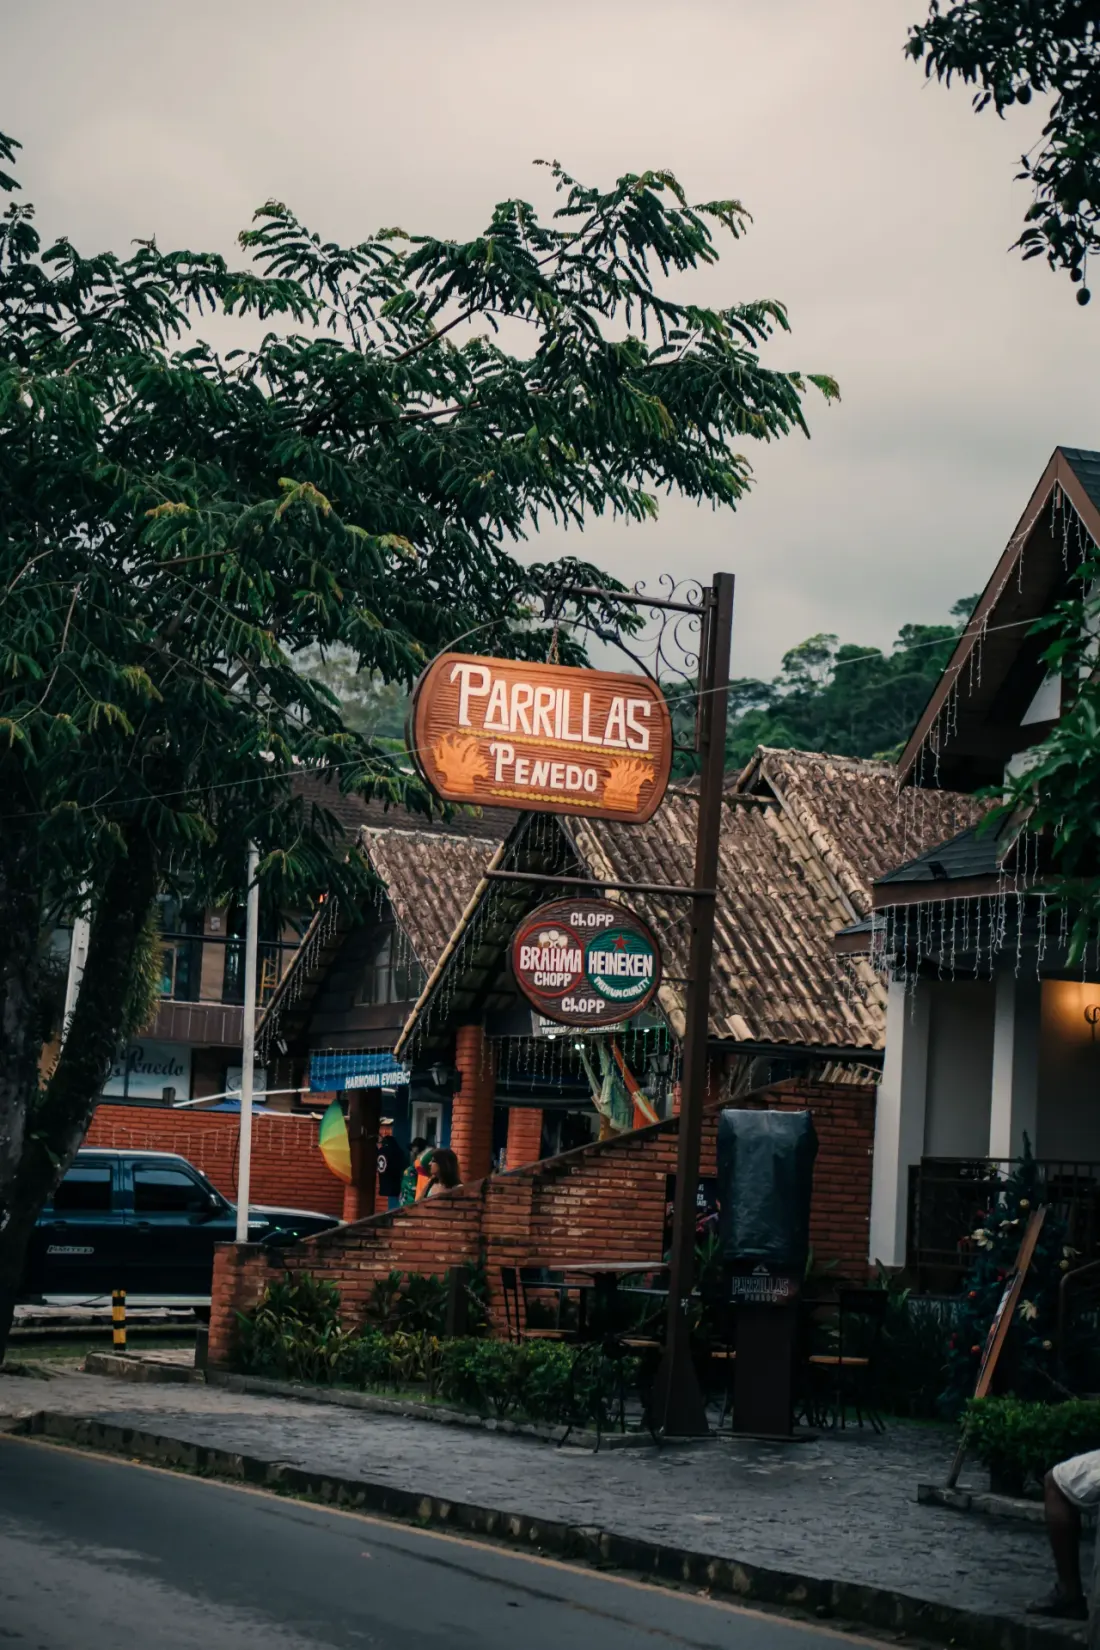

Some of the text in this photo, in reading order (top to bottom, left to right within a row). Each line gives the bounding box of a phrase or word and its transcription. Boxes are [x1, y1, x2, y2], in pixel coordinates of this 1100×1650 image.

[450, 663, 651, 751] PARRILLAS
[490, 743, 598, 792] PENEDO
[520, 946, 582, 973] BRAHMA
[588, 951, 653, 977] HEINEKEN
[534, 971, 572, 987] CHOPP
[623, 977, 650, 998] QUALITY
[345, 1073, 380, 1089] HARMONIA
[732, 1276, 789, 1297] PARRILLAS
